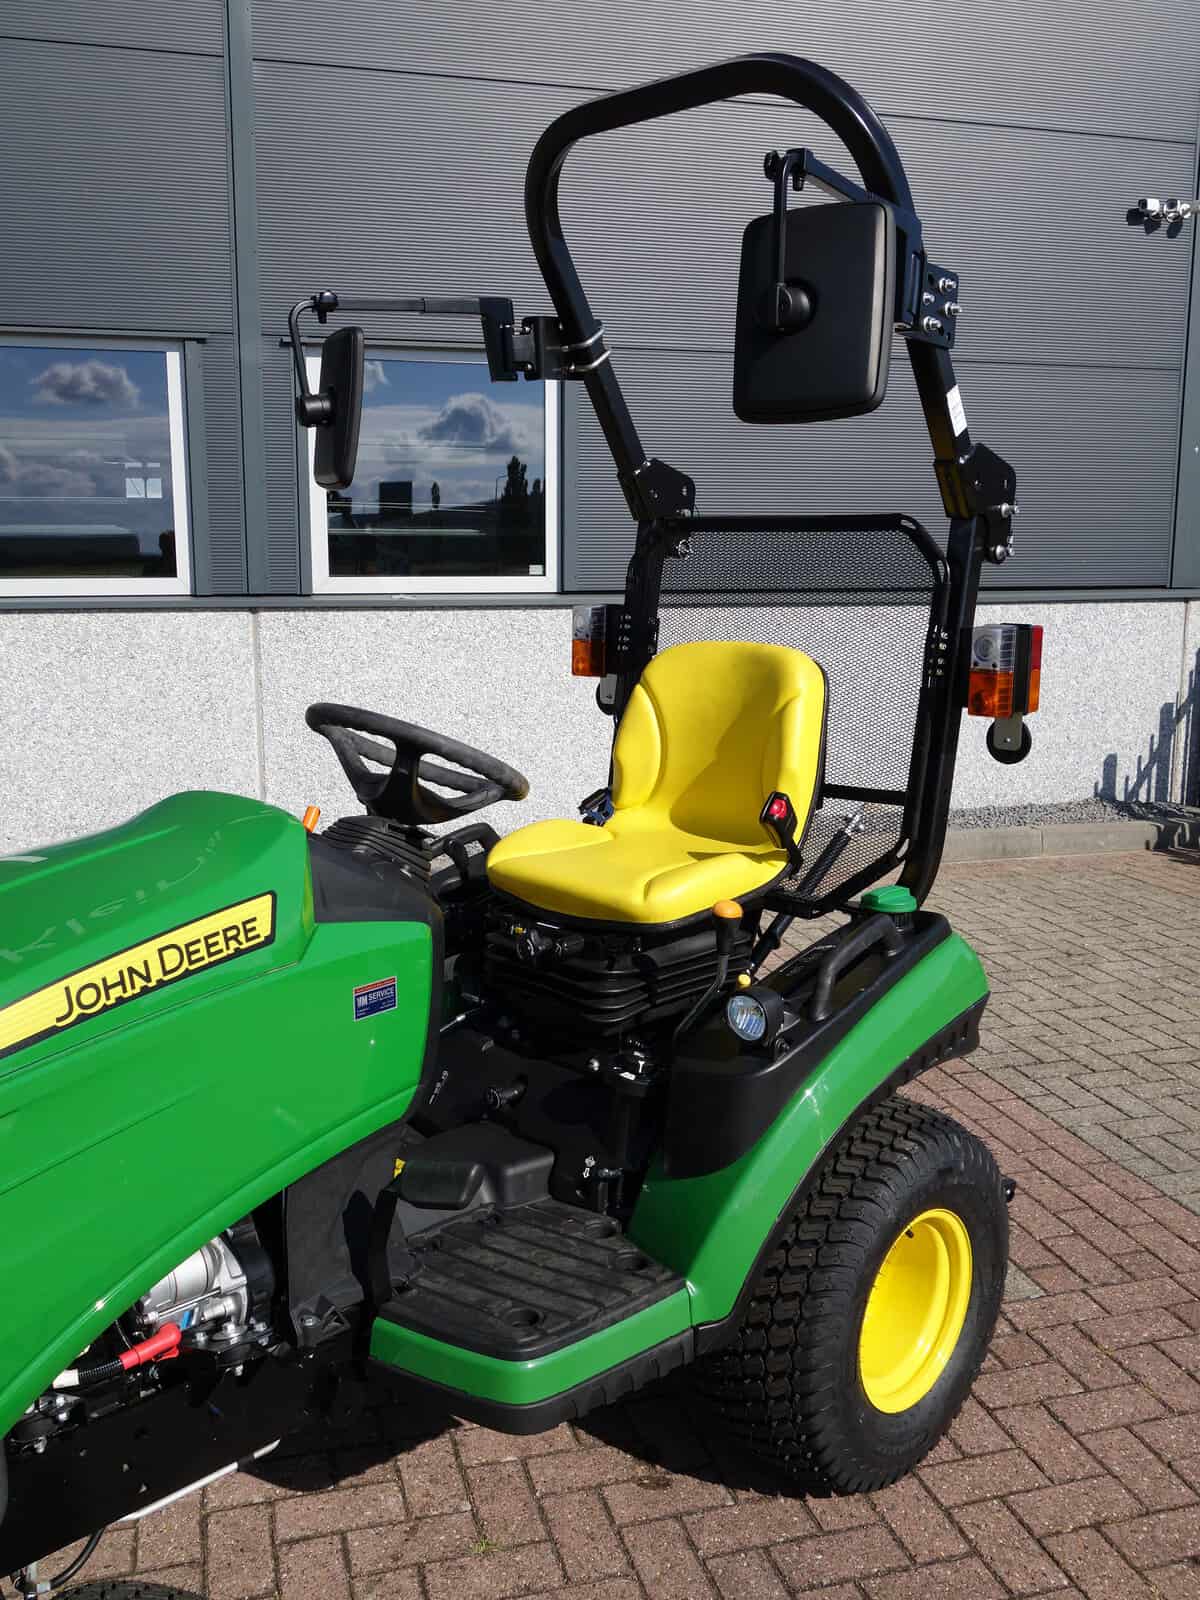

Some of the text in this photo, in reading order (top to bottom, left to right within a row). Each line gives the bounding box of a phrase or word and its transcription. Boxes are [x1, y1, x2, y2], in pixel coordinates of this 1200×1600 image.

[56, 917, 260, 1023] JOHN DEERE
[368, 986, 394, 1001] SERVICE
